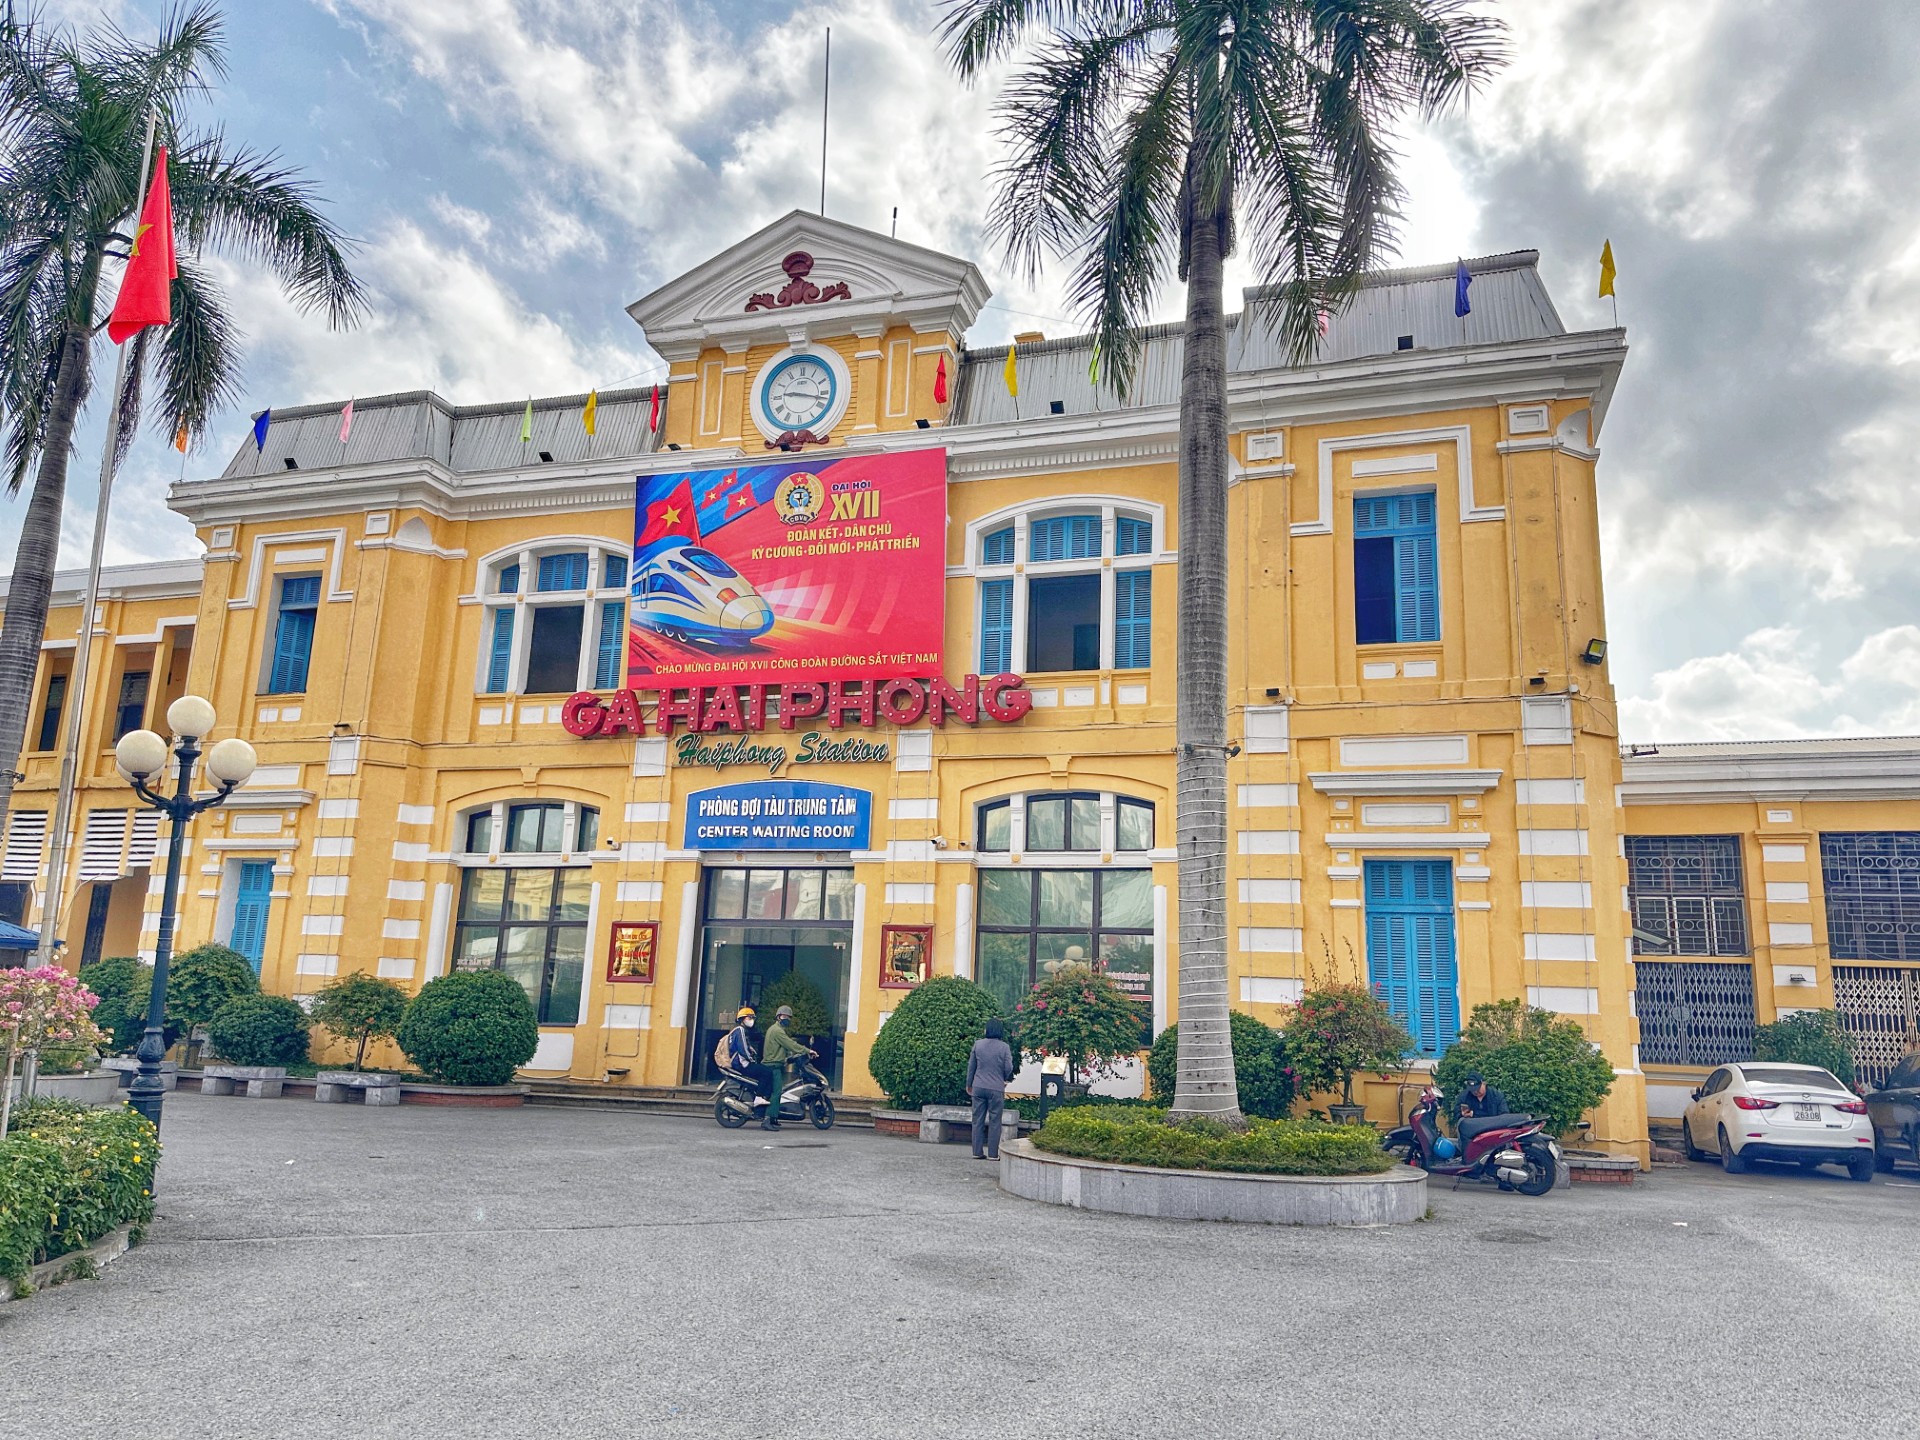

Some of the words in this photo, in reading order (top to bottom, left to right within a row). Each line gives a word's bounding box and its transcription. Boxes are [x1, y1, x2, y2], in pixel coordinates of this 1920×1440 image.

[832, 483, 849, 492] ĐẠI
[852, 480, 871, 491] HỘI
[829, 490, 880, 521] XVII
[787, 527, 817, 542] ĐOÀN
[819, 524, 838, 540] KẾT
[845, 523, 866, 538] DÂN
[868, 520, 892, 535] CHỦ
[766, 546, 803, 558] CƯƠNG
[808, 540, 827, 556] ĐỔI
[829, 540, 850, 554] MỚI
[856, 538, 887, 552] PHÁT
[887, 533, 920, 549] TRIỂN
[656, 662, 682, 674] CHÀO
[684, 662, 711, 673] MỪNG
[714, 662, 729, 673] ĐẠI
[732, 659, 748, 672] HỘI
[750, 661, 768, 670] XVII
[770, 657, 798, 669] CÔNG
[802, 656, 828, 668] ĐOÀN
[831, 654, 866, 667] ĐƯỜNG
[868, 651, 888, 665] SẮT
[891, 652, 912, 665] VIỆT
[915, 652, 938, 664] NAM
[562, 689, 645, 736] GA
[656, 684, 766, 734] HAI
[779, 673, 1033, 730] PHONG
[676, 732, 787, 774] Haiphong
[794, 731, 889, 764] Station
[699, 795, 738, 816] PHÒNG
[741, 797, 761, 820] ĐỢI
[764, 795, 785, 816] TÀU
[788, 798, 827, 816] TRUNG
[831, 794, 857, 815] TÂM
[698, 825, 748, 838] CENTER
[752, 825, 810, 838] WAITING
[813, 825, 854, 838] ROOM
